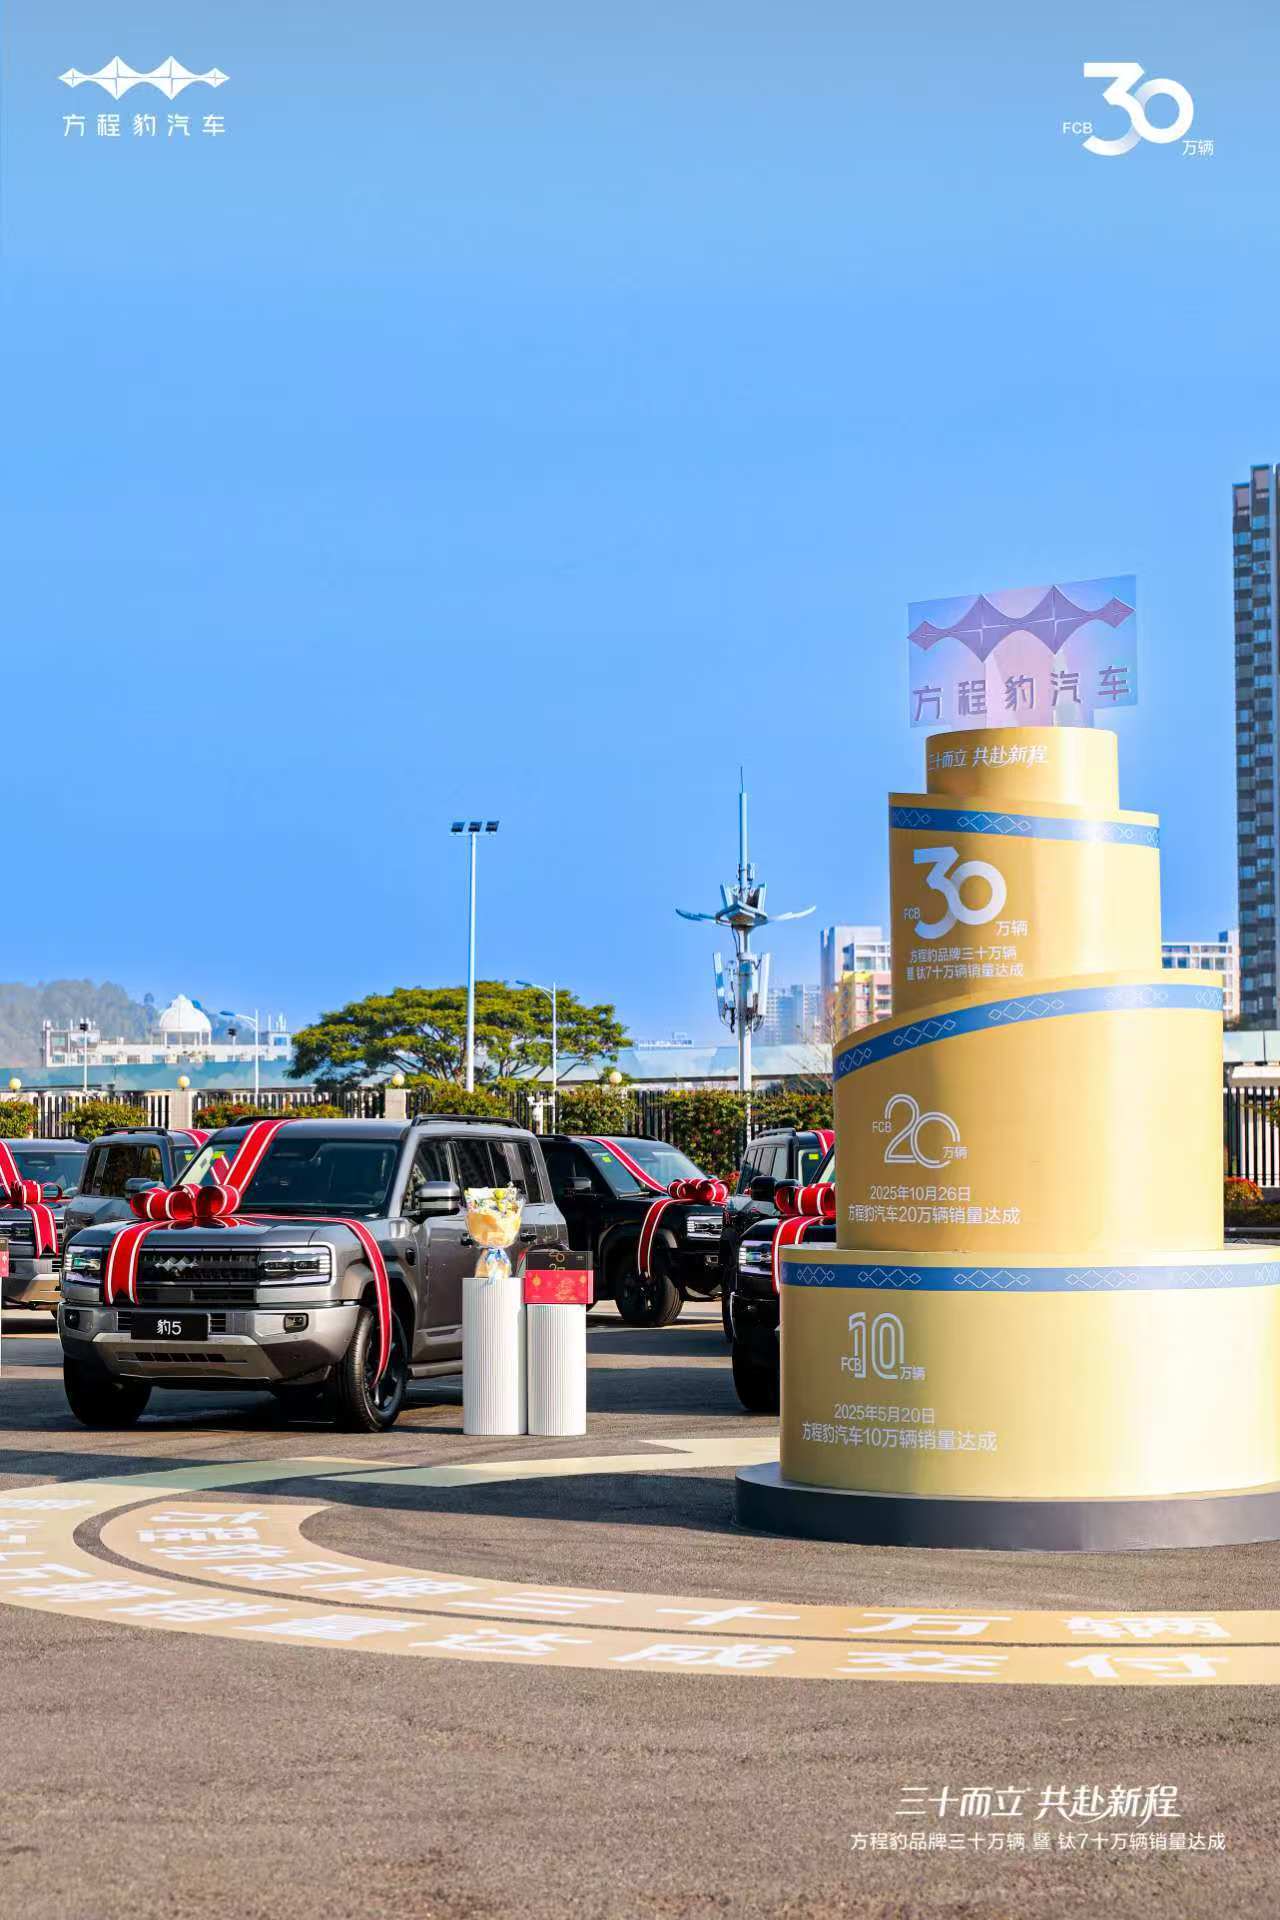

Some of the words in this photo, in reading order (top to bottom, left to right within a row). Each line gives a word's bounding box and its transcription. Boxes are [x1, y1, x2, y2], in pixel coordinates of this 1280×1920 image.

[911, 665, 1130, 722] 方程豹汽车
[972, 744, 1049, 770] 共赴新程
[913, 846, 1007, 940] 30
[994, 920, 1028, 937] 万辆
[871, 1121, 893, 1134] FCB
[884, 1093, 960, 1169] 20
[943, 1145, 969, 1161] 万辆
[869, 1185, 972, 1202] 2025年10月26日
[848, 1203, 1022, 1225] 方程豹汽车20万辆销量达成
[156, 1319, 182, 1335] 豹5
[848, 1311, 905, 1380] 10
[840, 1356, 863, 1372] FCB
[899, 1366, 927, 1381] 万辆
[833, 1403, 935, 1424] 2025年5月20日
[802, 1421, 999, 1451] 方程豹汽车10万辆销量达成
